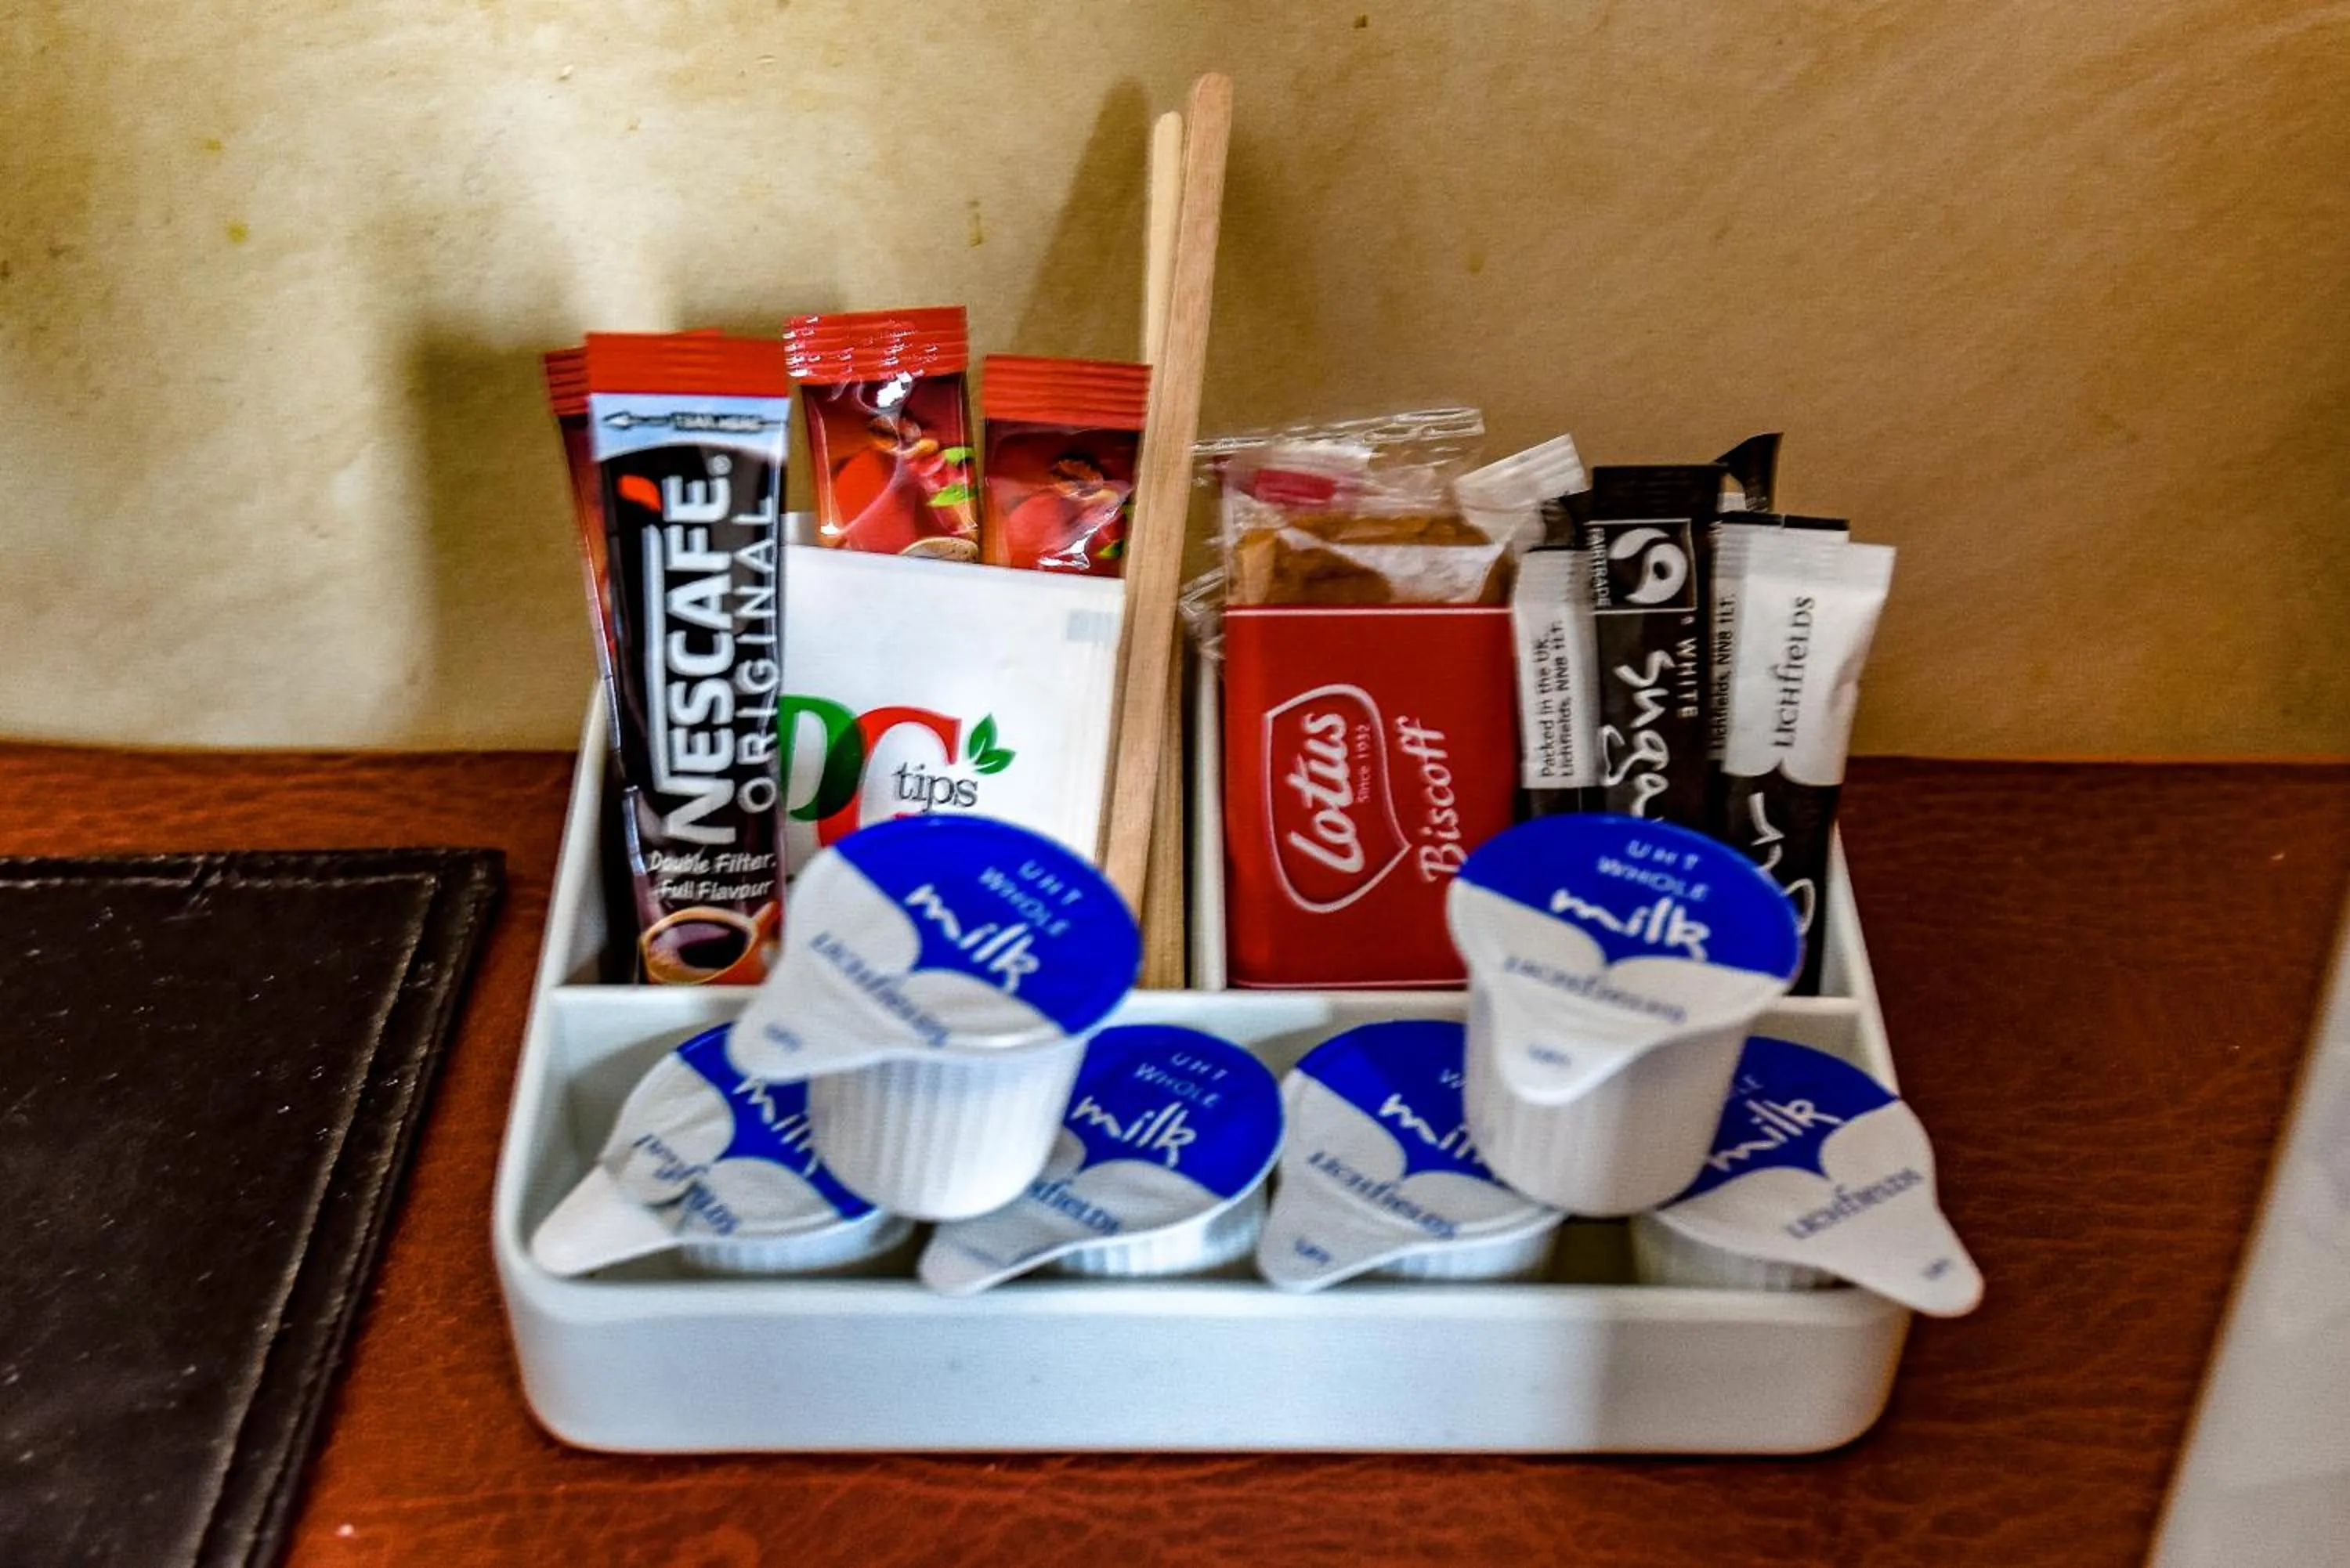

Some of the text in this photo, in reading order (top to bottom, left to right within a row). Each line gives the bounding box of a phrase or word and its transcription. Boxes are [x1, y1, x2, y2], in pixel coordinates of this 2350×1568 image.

[1586, 526, 1611, 609] FAIRTRADE
[732, 496, 780, 815] ORIGINAL
[1716, 630, 1733, 666] NN8
[1536, 667, 1554, 695] the
[1553, 656, 1571, 692] NN8
[1675, 636, 1699, 719] WHITE
[1535, 699, 1554, 715] in
[1538, 719, 1556, 778] Packed
[1600, 649, 1676, 822] Suga
[892, 762, 978, 813] tips
[1355, 764, 1372, 804] Since
[1397, 714, 1469, 883] Biscoff
[647, 849, 710, 875] Double
[1596, 855, 1711, 903] WHOLE
[1625, 839, 1700, 872] UHT
[656, 878, 775, 901] Full Flavour
[978, 865, 1071, 937] WHOLE
[1018, 858, 1083, 906] UHT
[904, 883, 1041, 992] milk
[1549, 887, 1711, 963] milk
[1133, 1061, 1224, 1109] WHOLE
[1171, 1051, 1229, 1081] UHT
[1070, 1094, 1197, 1168] milk
[1706, 1098, 1844, 1172] milk
